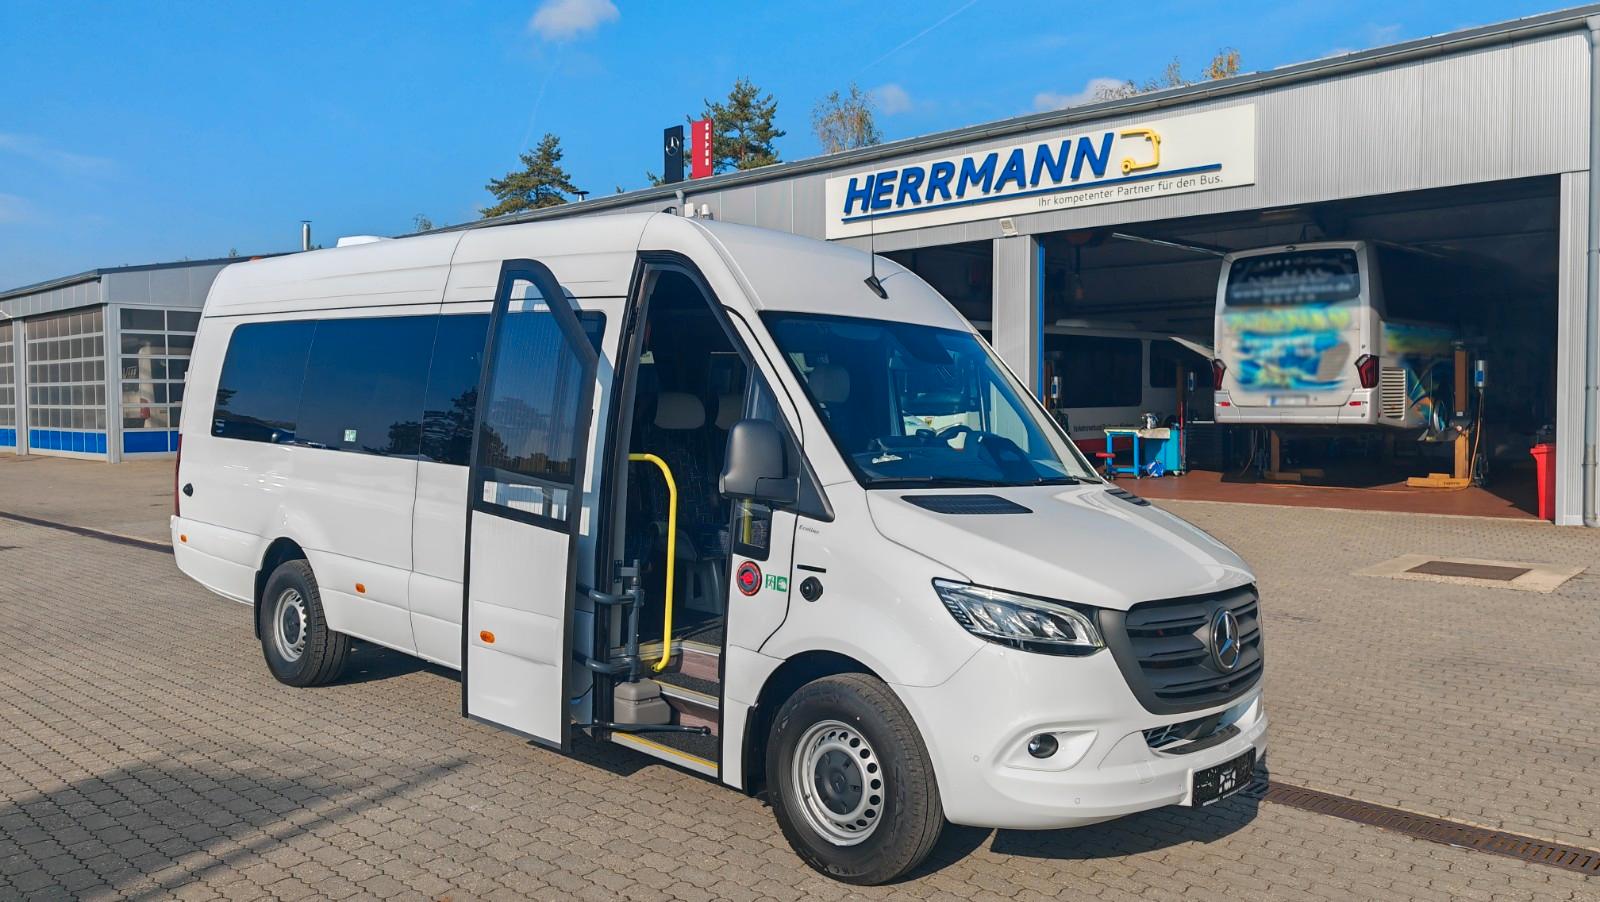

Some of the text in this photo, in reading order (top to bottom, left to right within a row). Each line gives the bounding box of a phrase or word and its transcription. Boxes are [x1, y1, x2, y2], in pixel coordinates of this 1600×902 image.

[844, 132, 1114, 214] HERRMANN
[1038, 174, 1223, 207] Ihr kompetenter Partner für den Bus.
